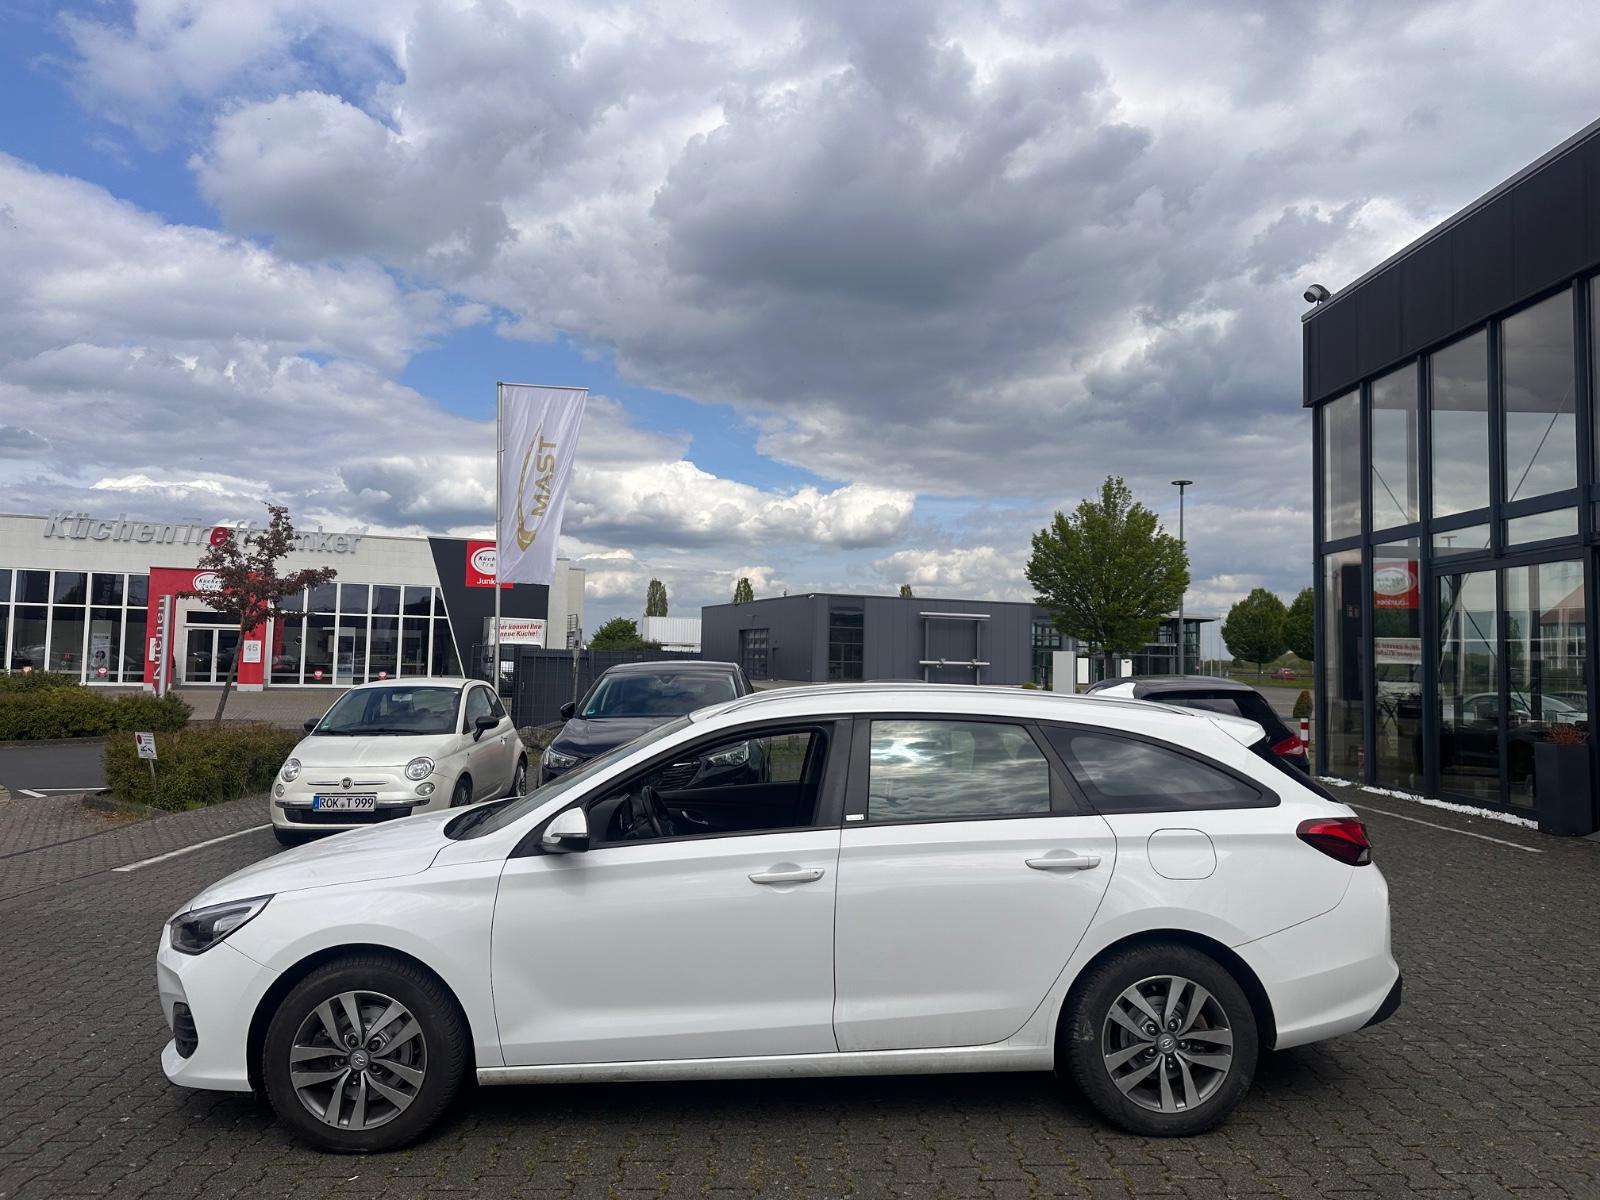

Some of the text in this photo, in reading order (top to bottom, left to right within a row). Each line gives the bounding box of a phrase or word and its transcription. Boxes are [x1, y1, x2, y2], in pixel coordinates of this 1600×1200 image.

[530, 436, 557, 517] MAST
[477, 577, 496, 585] Junk
[246, 643, 259, 652] 45
[320, 797, 374, 808] ROK T 999
